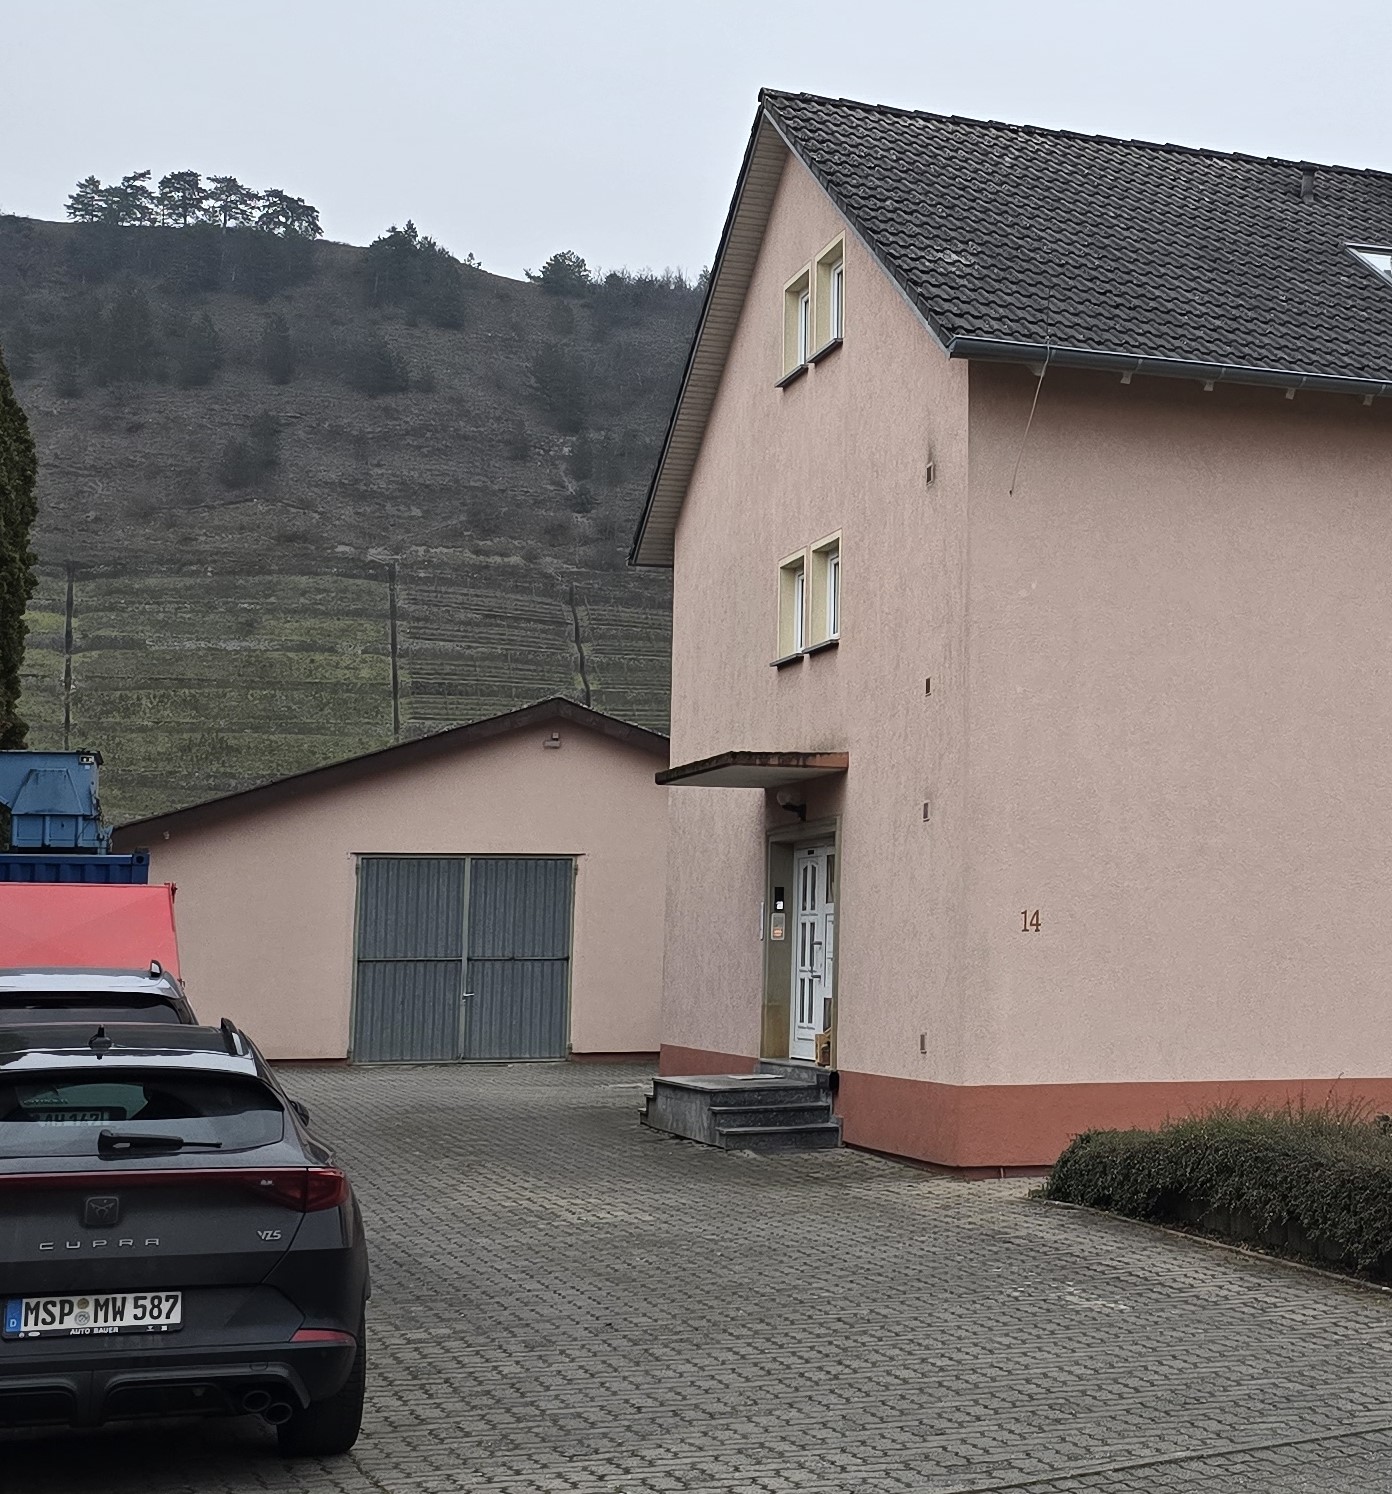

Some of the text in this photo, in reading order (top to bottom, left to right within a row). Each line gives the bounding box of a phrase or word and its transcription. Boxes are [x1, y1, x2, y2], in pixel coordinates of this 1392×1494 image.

[1021, 909, 1041, 932] 14
[257, 1230, 282, 1241] VZ5
[39, 1238, 160, 1250] CUPRA
[23, 1295, 179, 1328] MSP MW 587
[9, 1317, 18, 1328] D
[69, 1326, 119, 1336] AUTO BAUER
